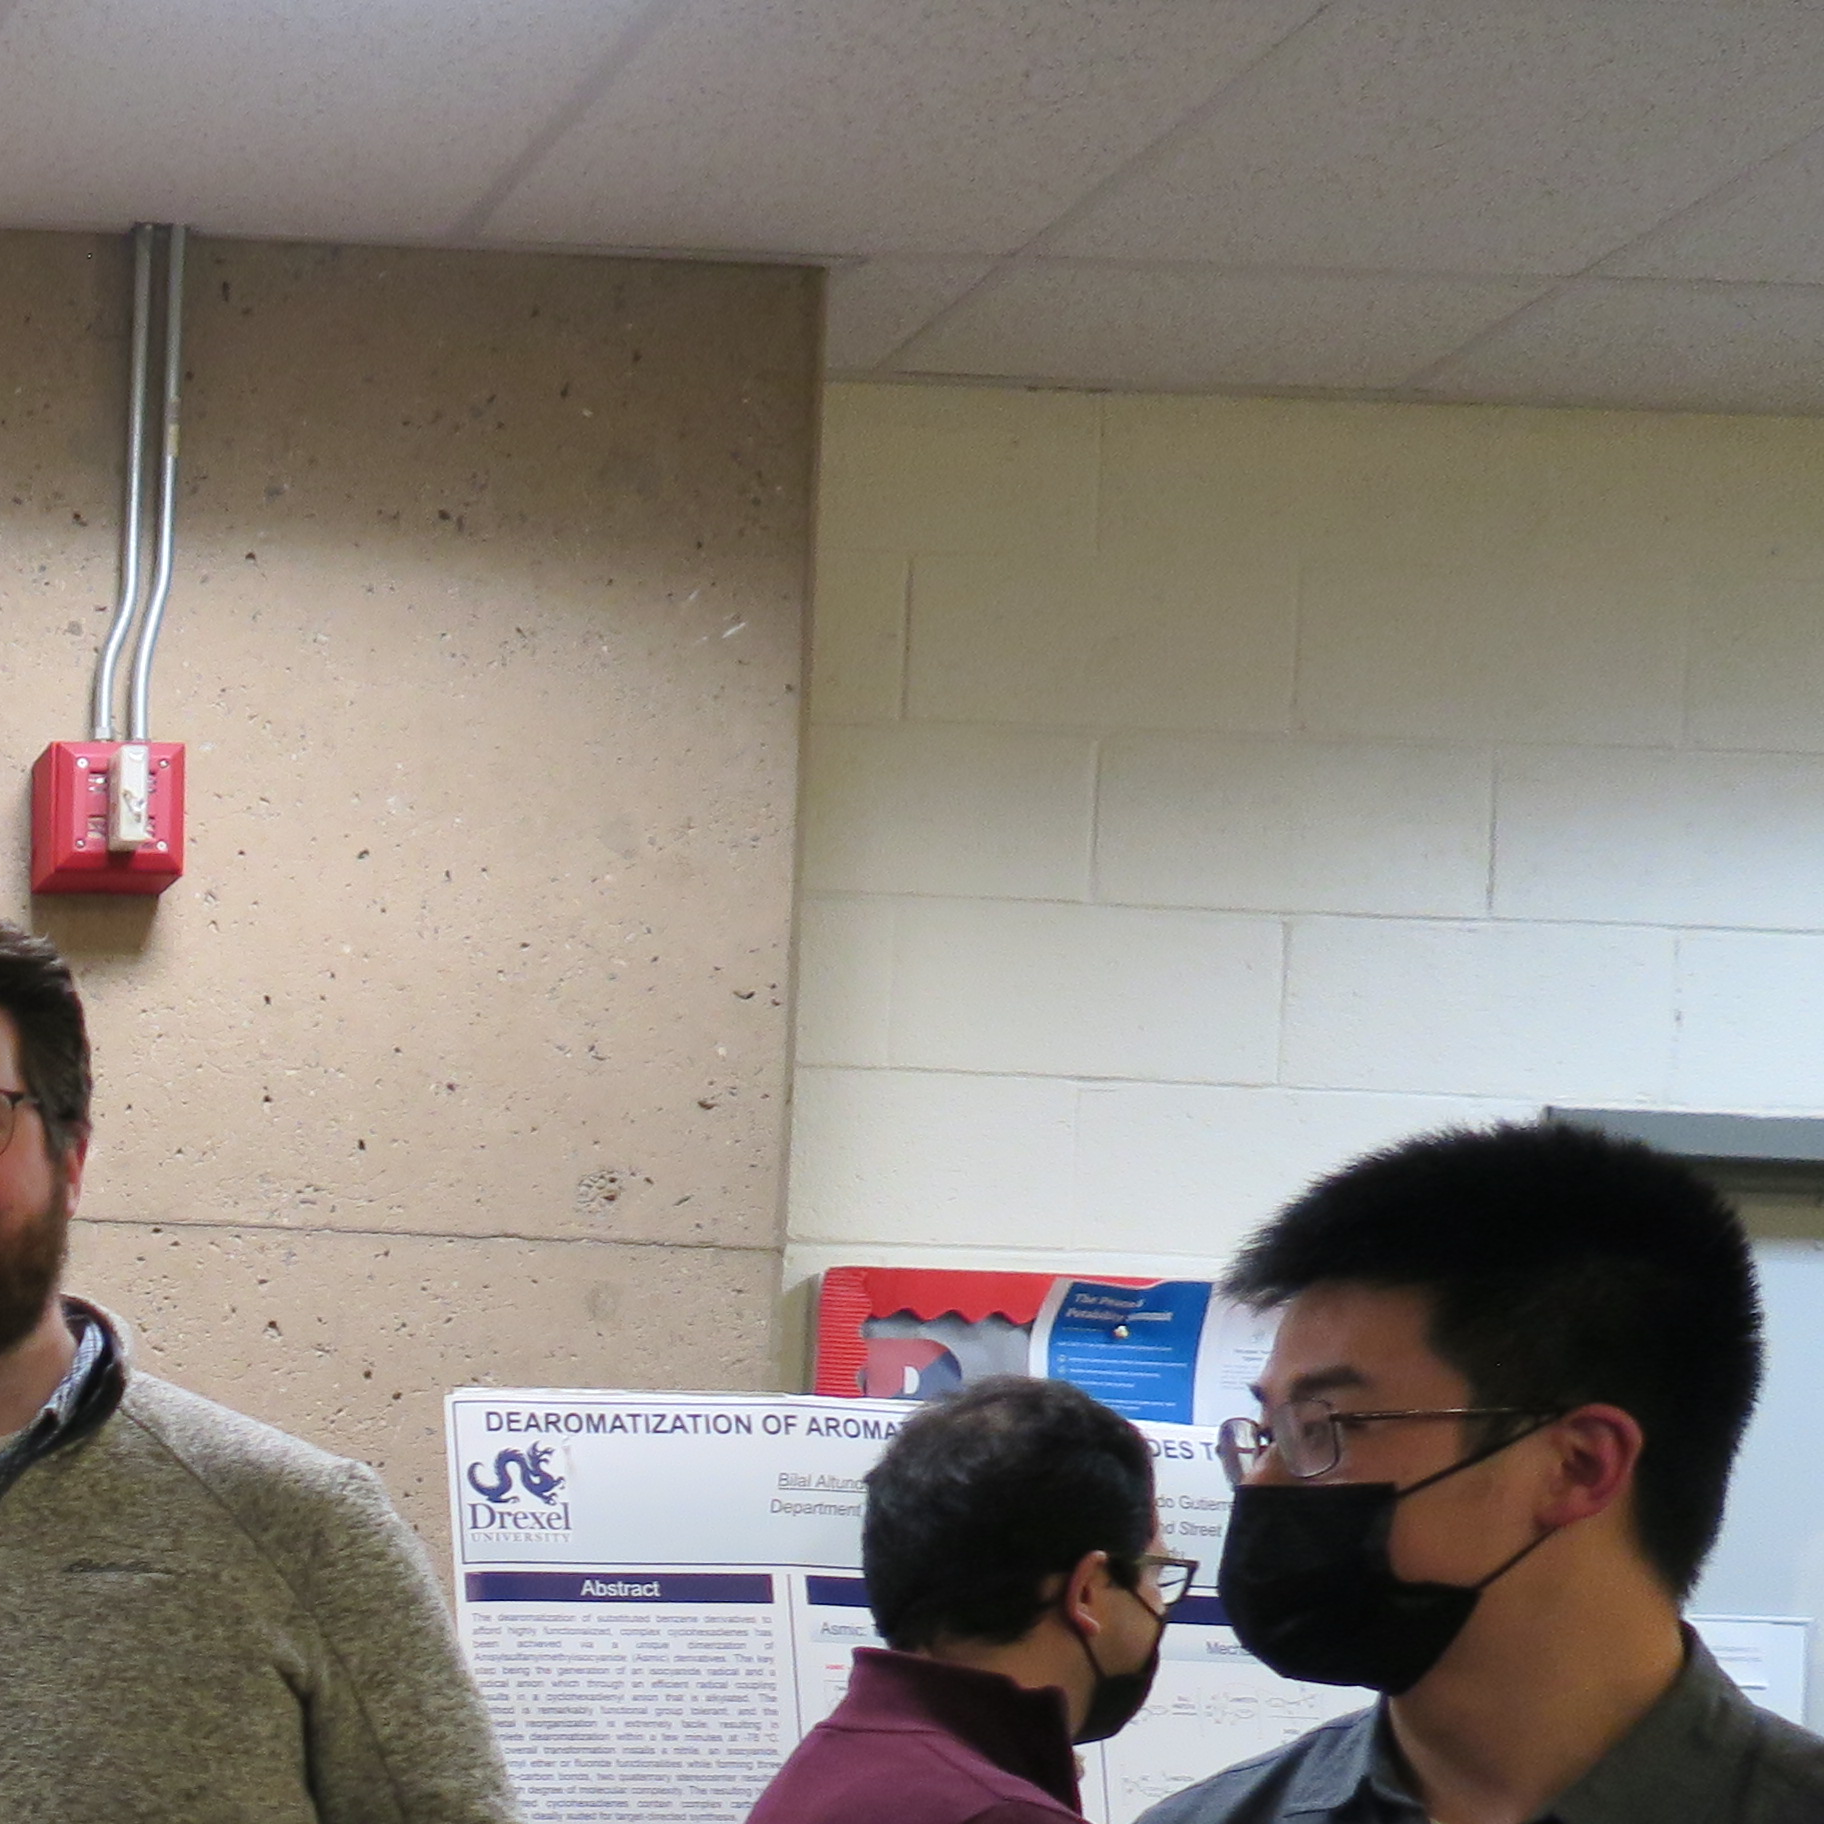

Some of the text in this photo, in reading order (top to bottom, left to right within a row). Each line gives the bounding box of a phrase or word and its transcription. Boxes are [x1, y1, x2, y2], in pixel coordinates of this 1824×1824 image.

[485, 1411, 753, 1435] DEAROMATIZATION
[762, 1414, 797, 1436] OF
[806, 1416, 904, 1440] AROMA
[778, 1472, 811, 1488] Bilal
[770, 1499, 862, 1517] Department
[1179, 1495, 1236, 1512] Gutierr
[467, 1502, 572, 1531] Drexel
[471, 1532, 571, 1543] UNIVERSITY
[1179, 1522, 1222, 1537] Street
[580, 1579, 661, 1598] Abstract
